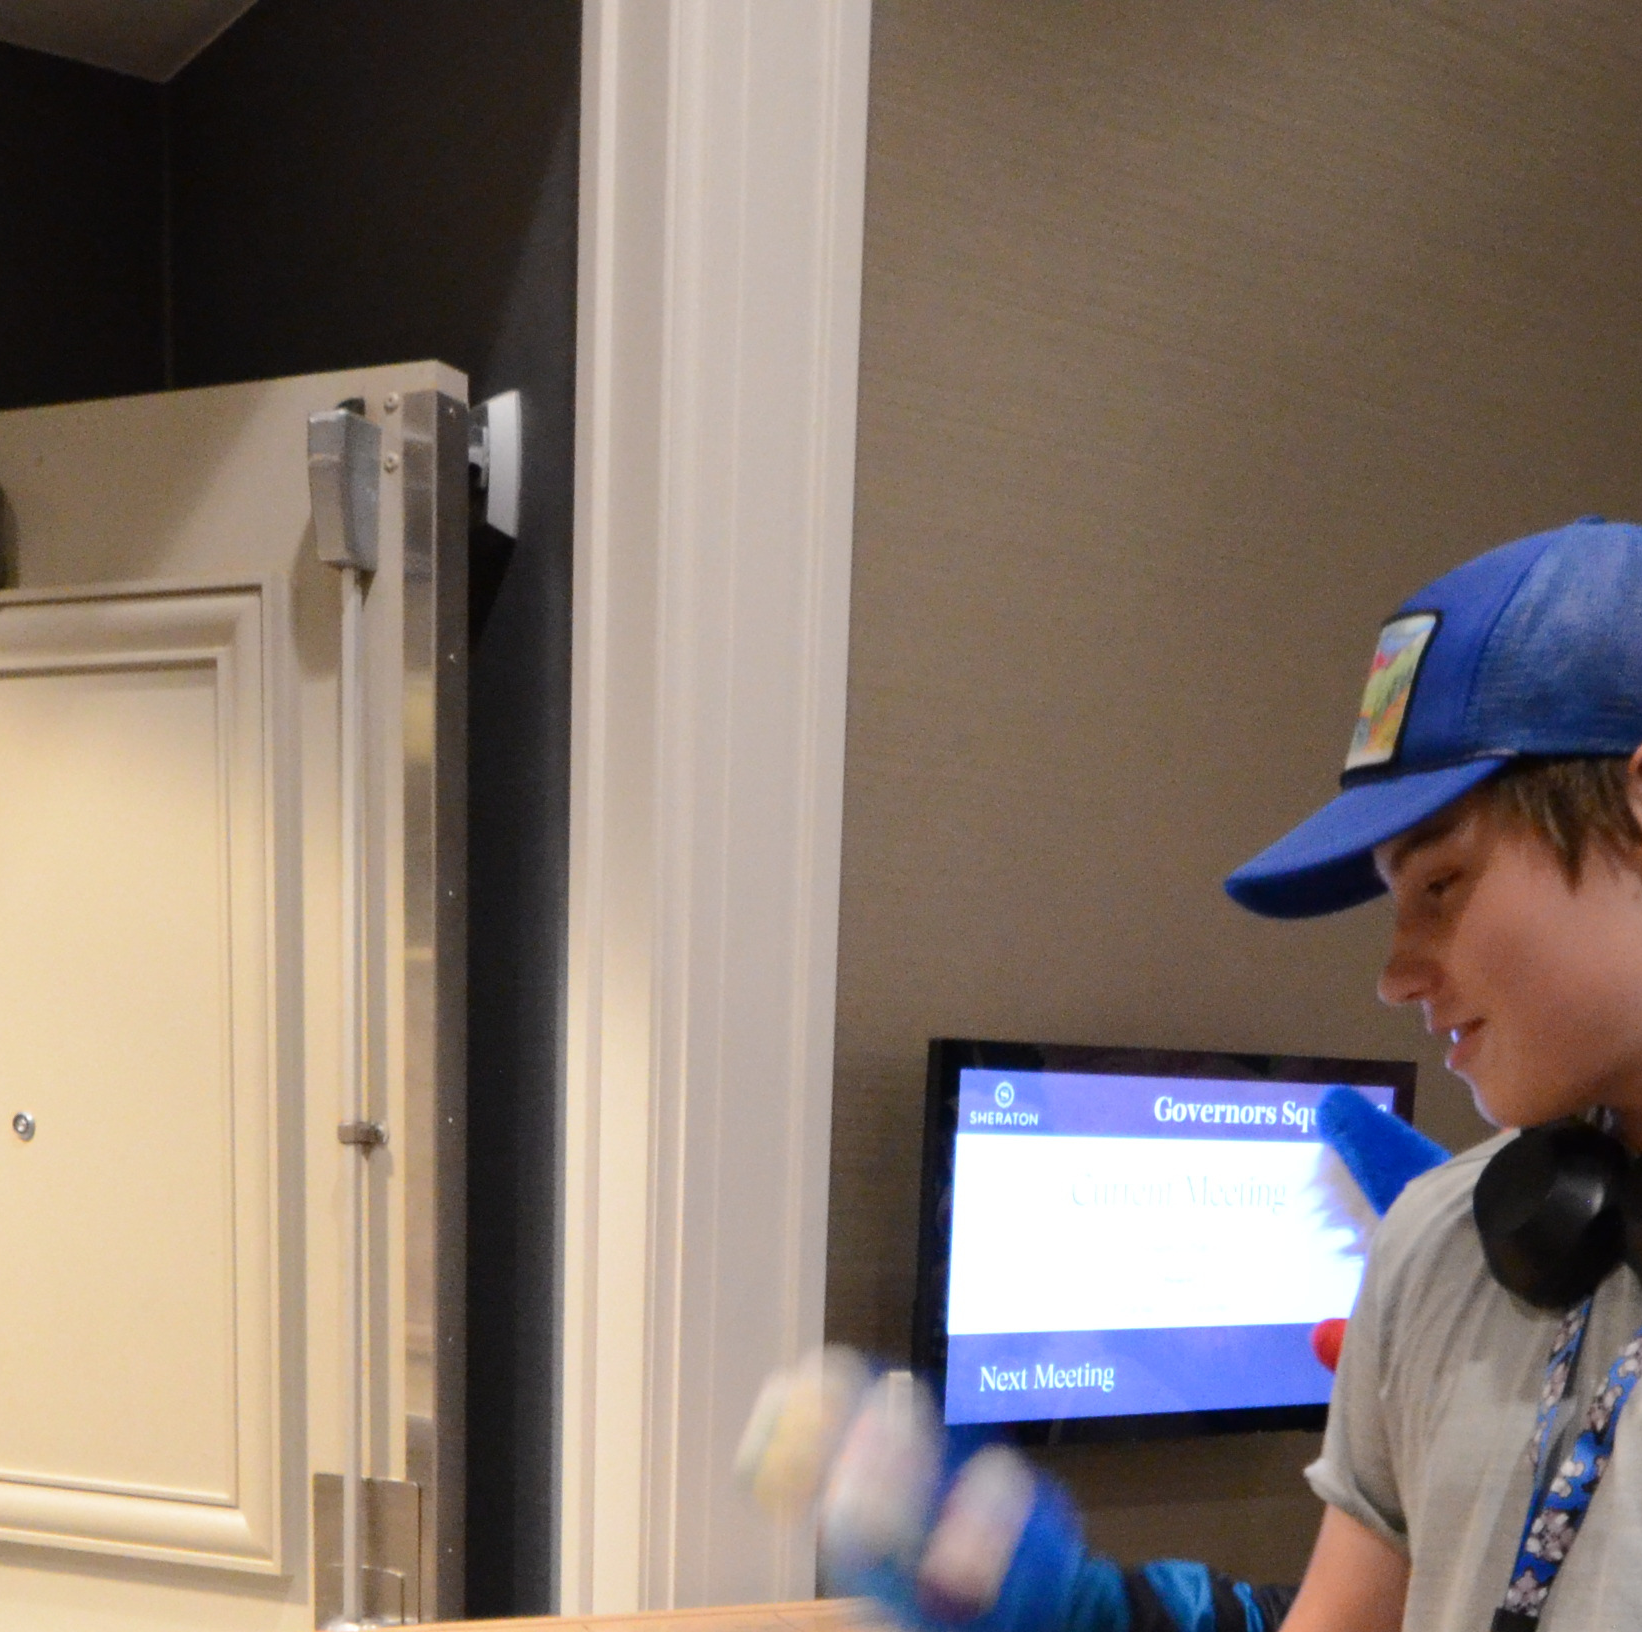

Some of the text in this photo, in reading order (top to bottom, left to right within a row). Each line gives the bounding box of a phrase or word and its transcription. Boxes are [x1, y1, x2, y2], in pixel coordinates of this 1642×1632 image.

[969, 1110, 1039, 1127] SHERATON
[1154, 1095, 1277, 1126] Governors
[1071, 1173, 1286, 1217] Current Meeting
[979, 1362, 1115, 1393] Next Meeting
